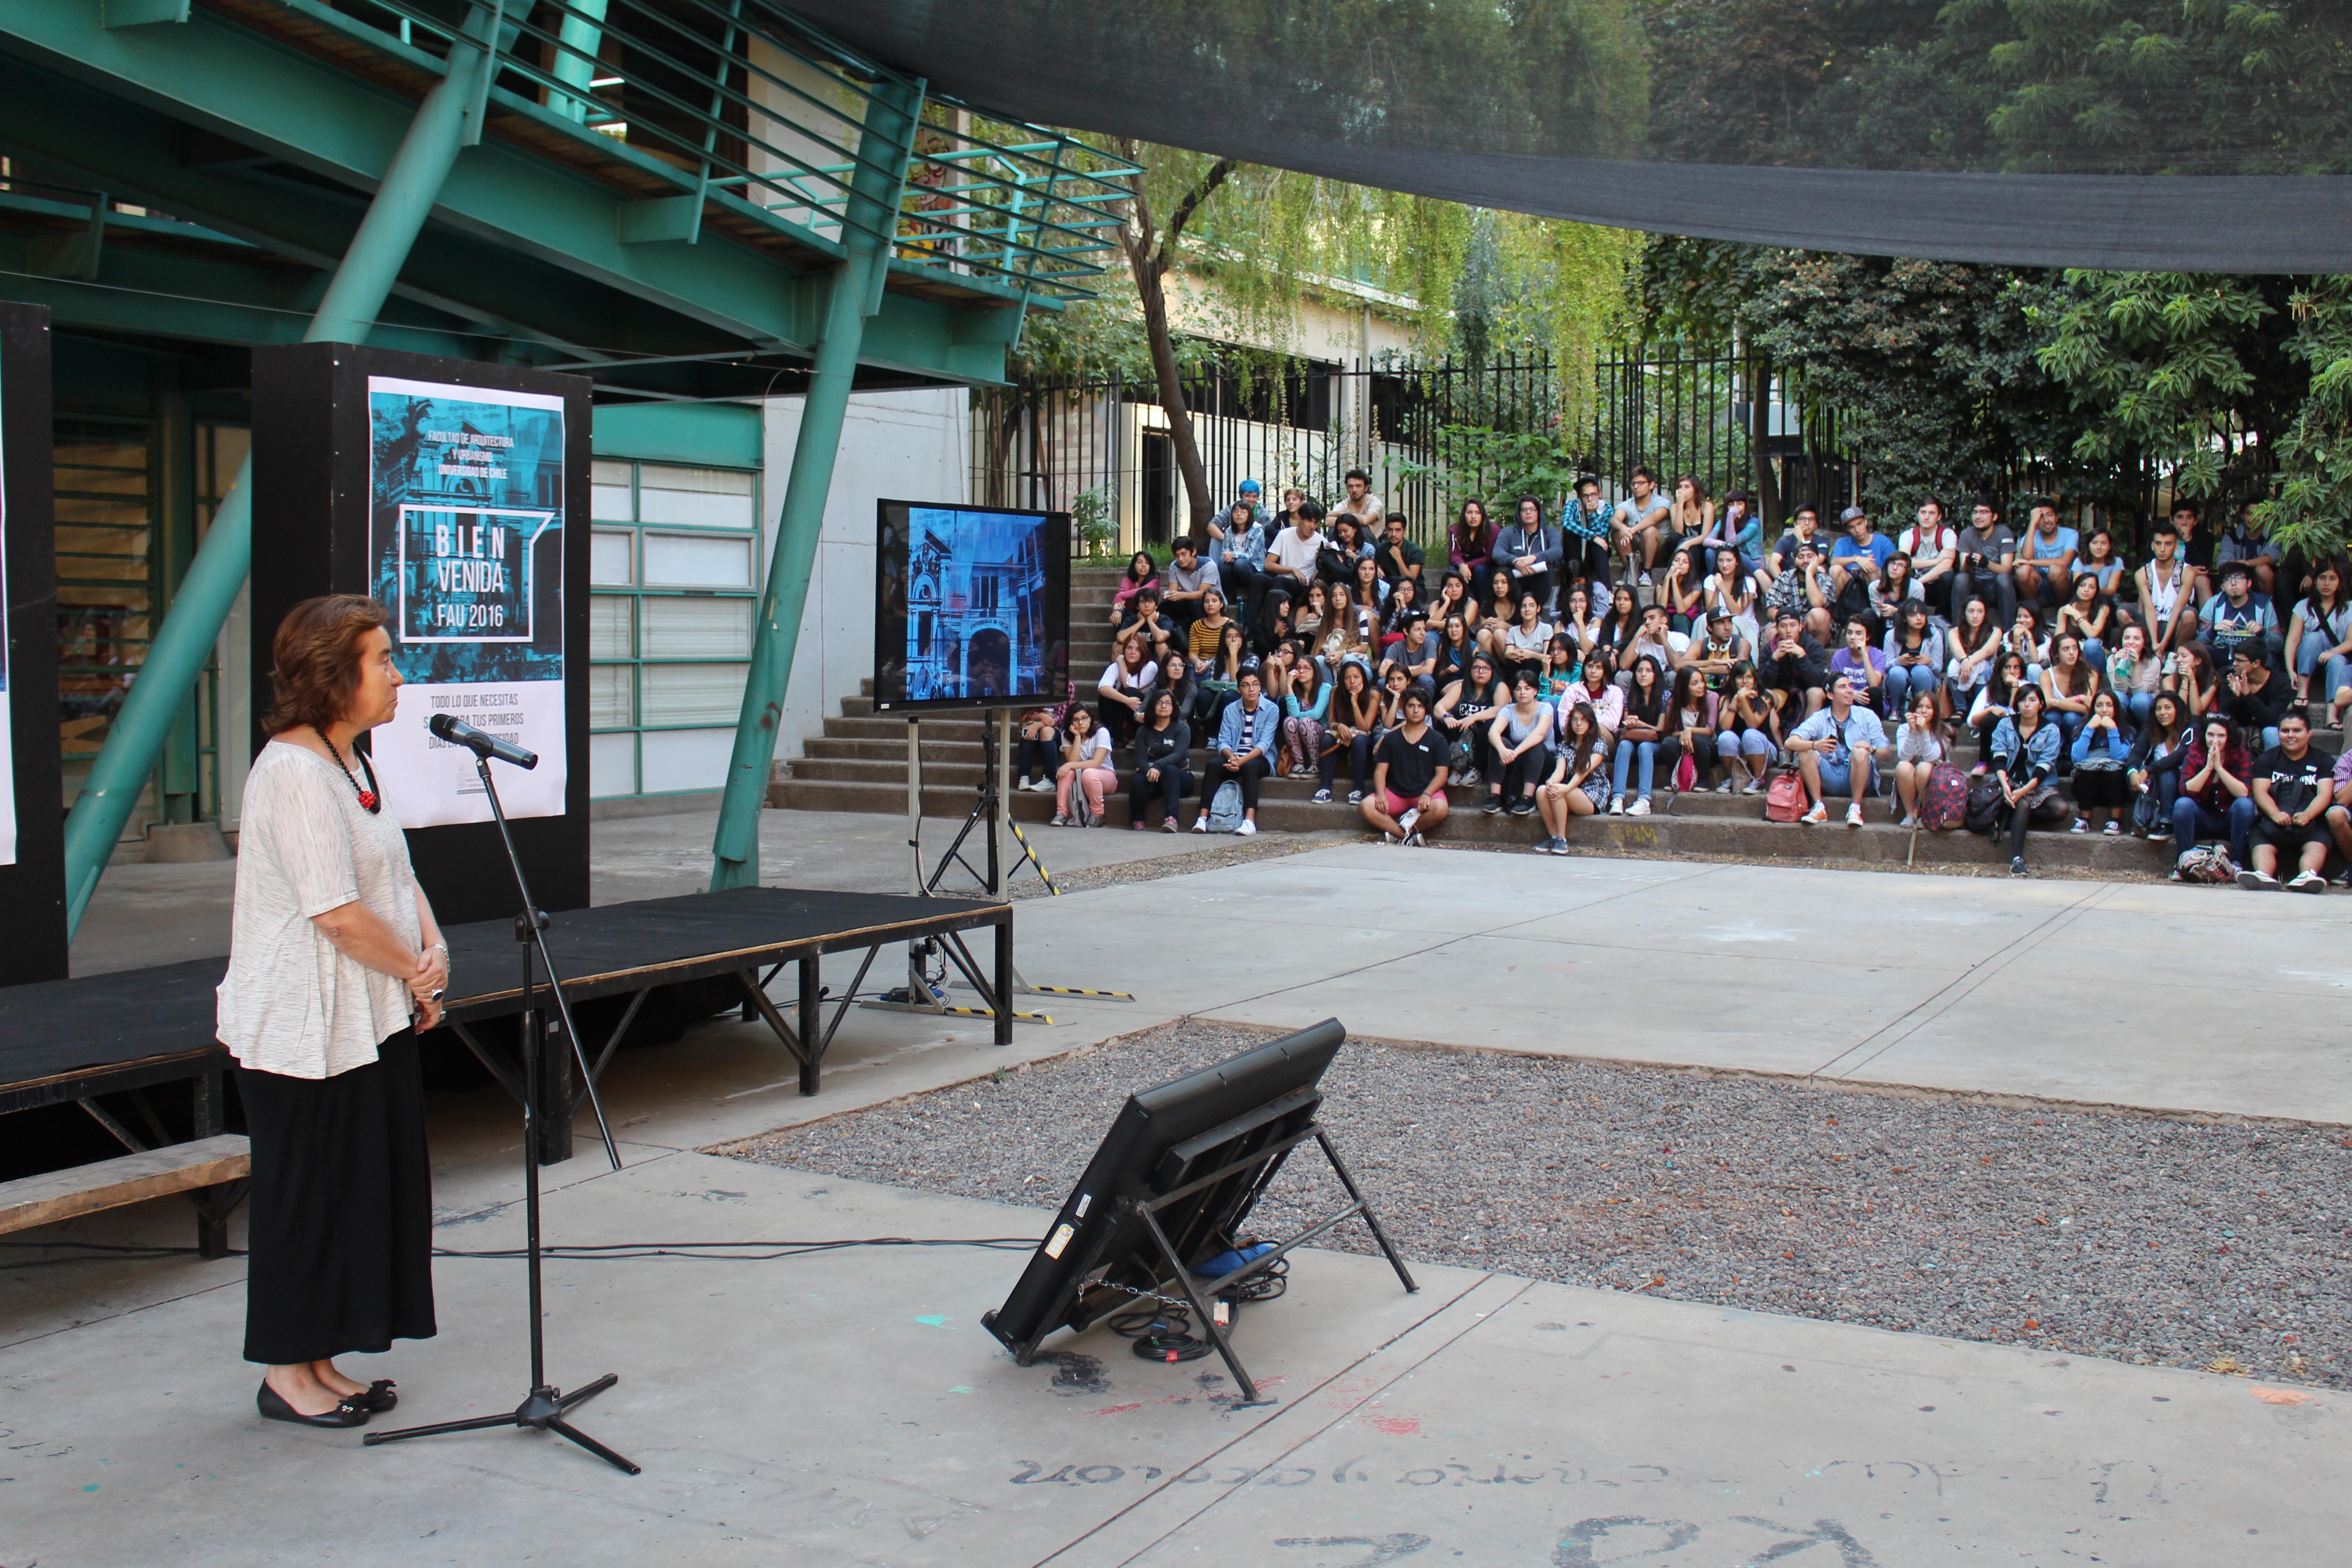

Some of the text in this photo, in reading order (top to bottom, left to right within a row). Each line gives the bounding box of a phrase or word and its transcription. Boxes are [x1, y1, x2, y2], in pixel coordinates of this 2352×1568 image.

[428, 430, 514, 448] FACULTAD DE ARQUITECTURA
[451, 448, 457, 460] Y
[458, 449, 493, 462] URBANISMO
[438, 465, 507, 479] UNIVERSIDAD DE CHILE
[436, 524, 505, 559] BIEN
[437, 560, 504, 593] VENIDA
[437, 604, 504, 627] FAU 2016
[431, 693, 518, 708] TODO LO QUE NECESITAS
[472, 714, 486, 727] TUS
[488, 712, 524, 726] PRIMEROS
